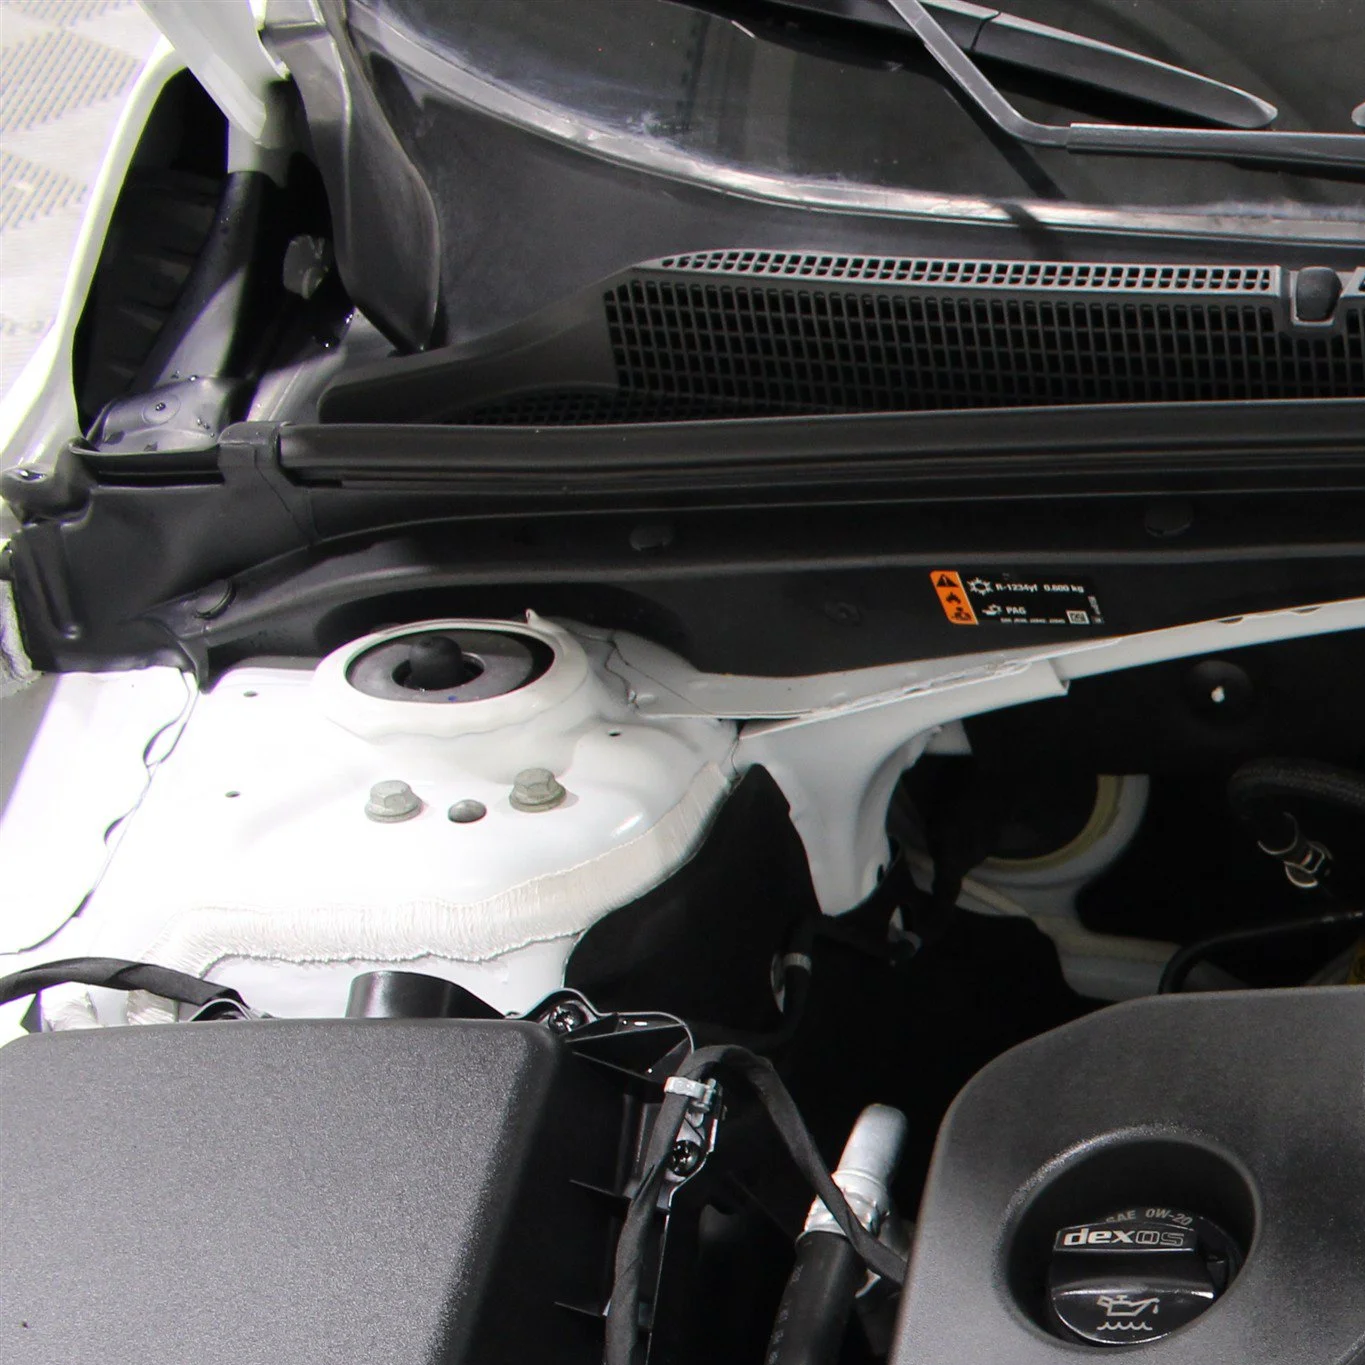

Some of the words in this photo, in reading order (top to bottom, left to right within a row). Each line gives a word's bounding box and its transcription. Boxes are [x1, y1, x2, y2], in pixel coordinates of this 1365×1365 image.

[1005, 606, 1027, 615] PAG
[1145, 1208, 1193, 1225] 0W-20
[1064, 1228, 1185, 1247] dexos
